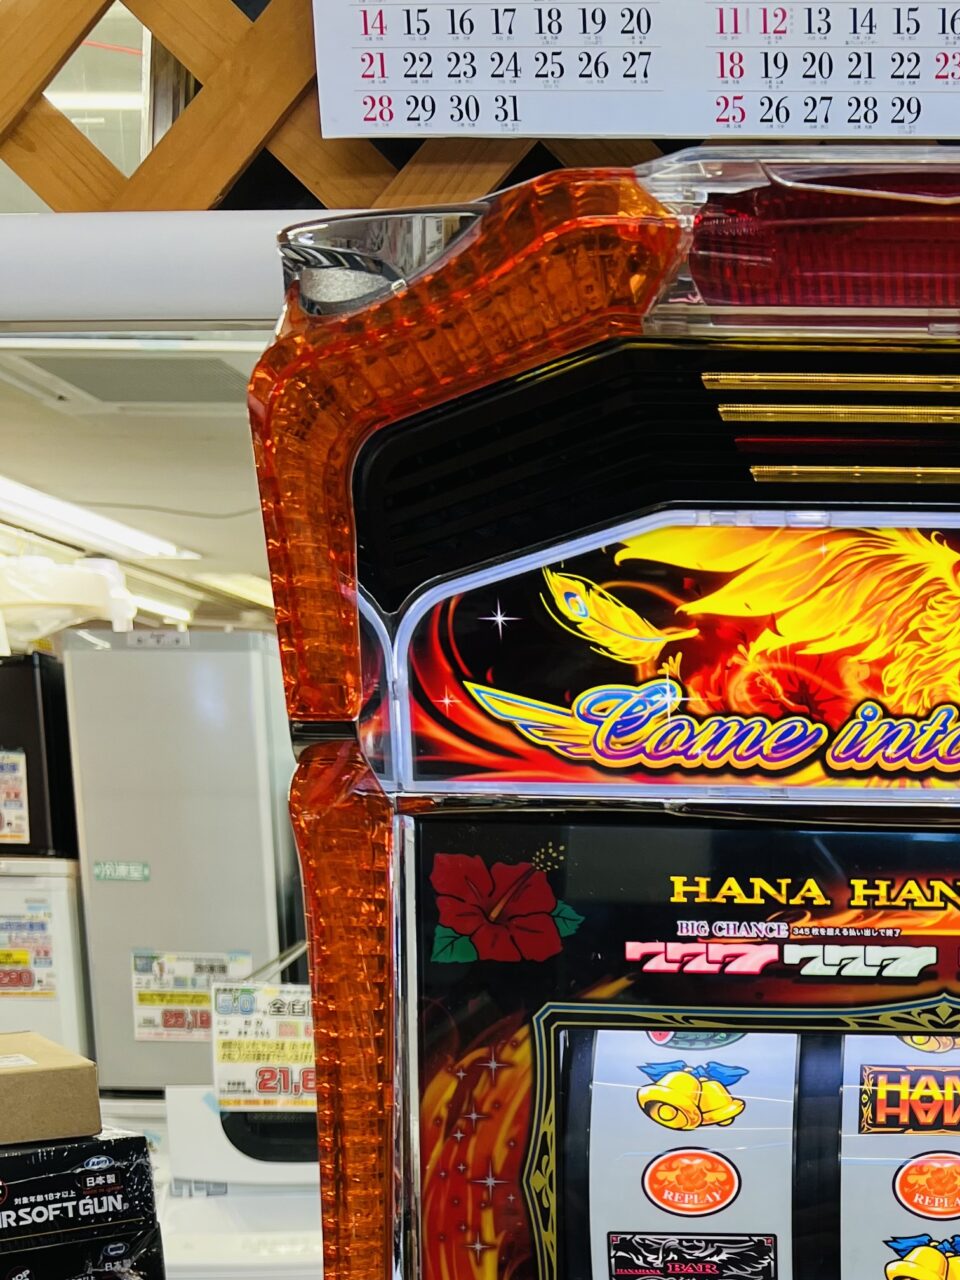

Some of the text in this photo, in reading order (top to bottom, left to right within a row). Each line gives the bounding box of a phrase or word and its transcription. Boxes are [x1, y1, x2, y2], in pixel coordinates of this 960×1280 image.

[360, 8, 651, 36] 14 15 16 17 18 19 20
[715, 7, 742, 35] 11
[759, 7, 787, 35] 12
[803, 7, 832, 35] 13
[848, 7, 877, 35] 14
[892, 7, 920, 35] 15
[360, 51, 652, 79] 21 22 23 24 25 26 27
[715, 51, 744, 80] 18
[760, 51, 788, 80] 19
[802, 51, 833, 80] 20
[847, 51, 876, 80] 21
[890, 51, 921, 80] 22
[362, 94, 522, 122] 28 29 30 31
[715, 95, 921, 124] 25 26 27 28 29
[575, 686, 824, 771] Come
[669, 876, 830, 906] HANA
[677, 921, 708, 936] BIG
[712, 921, 789, 938] CHANCE
[268, 998, 312, 1017] 全自
[662, 1188, 722, 1205] REPLAY
[666, 1262, 719, 1275] BAR
